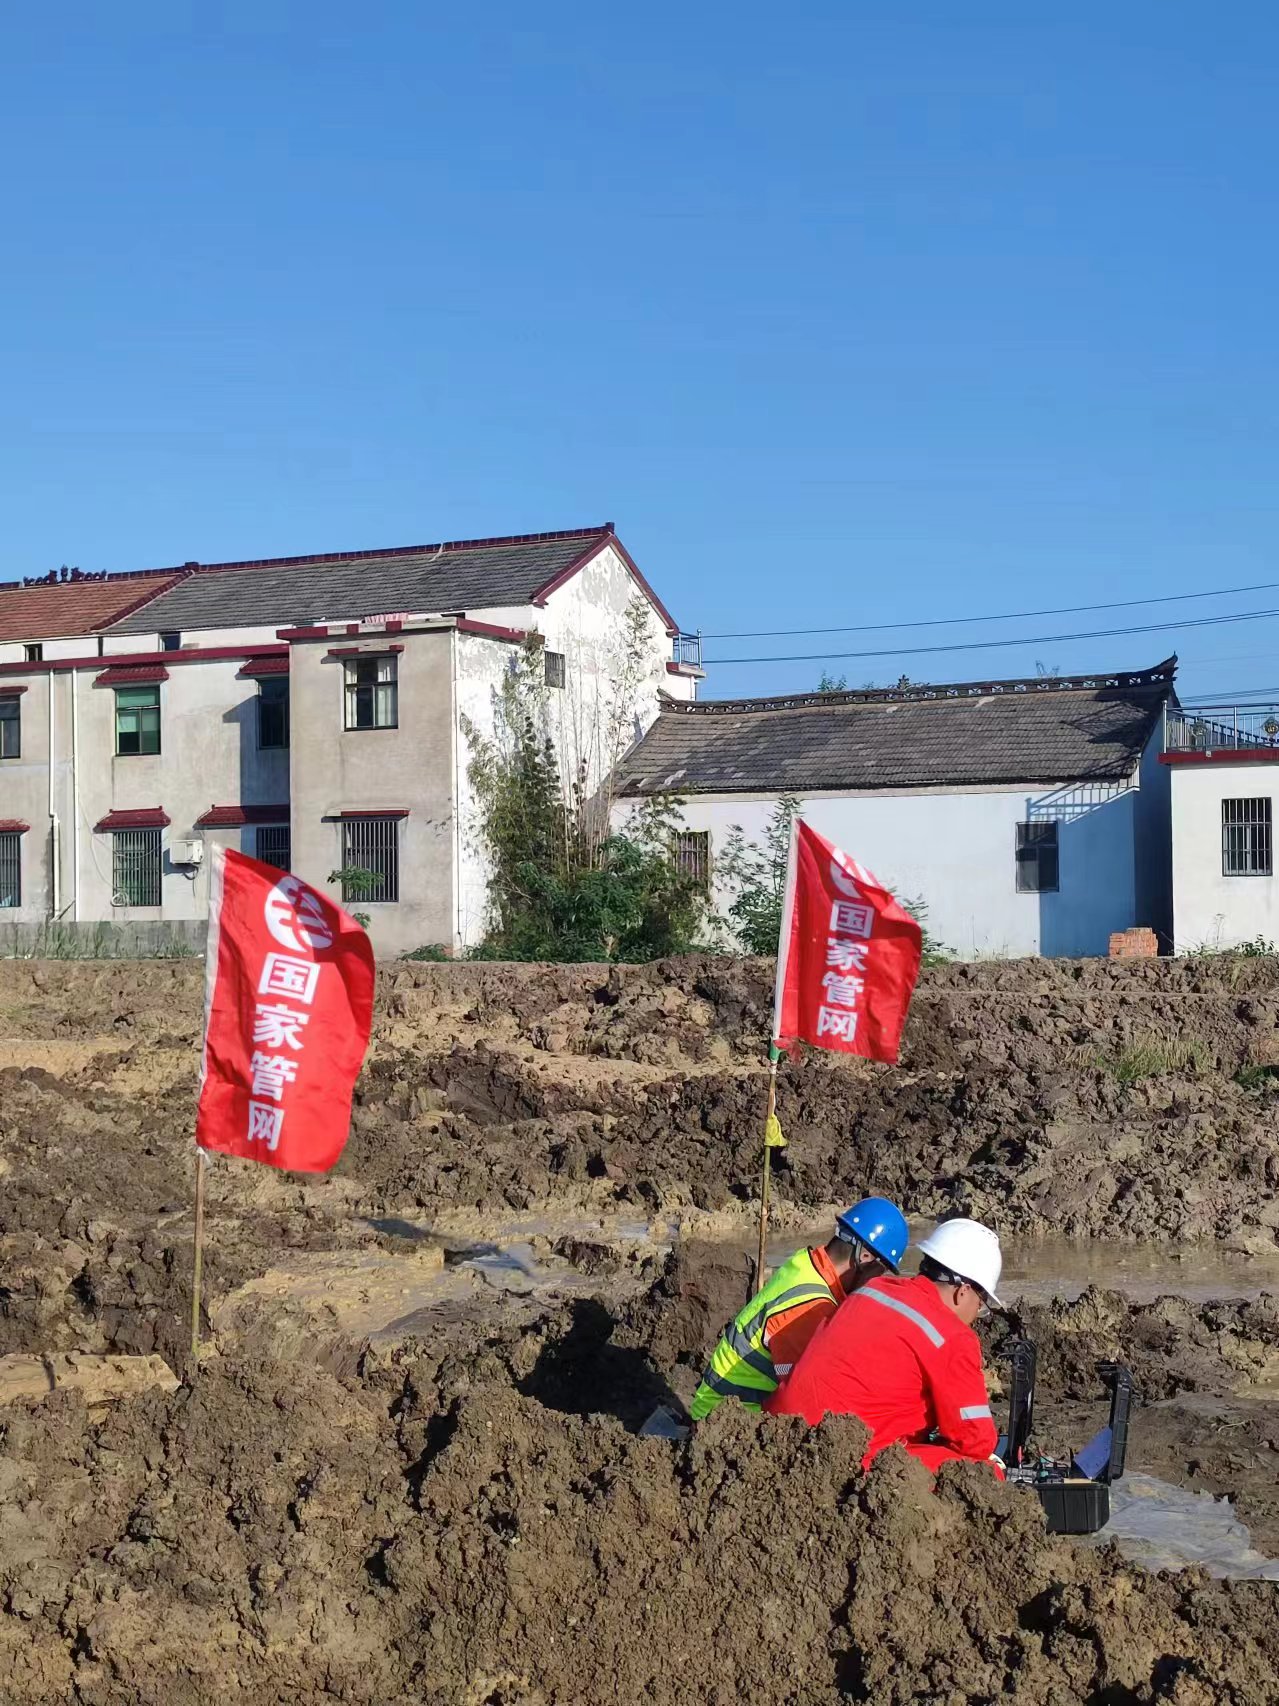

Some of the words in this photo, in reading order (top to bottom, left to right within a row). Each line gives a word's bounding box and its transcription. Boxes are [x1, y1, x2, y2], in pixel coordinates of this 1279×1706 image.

[247, 952, 321, 1150] 国家管网
[817, 899, 875, 1042] 国家管网
